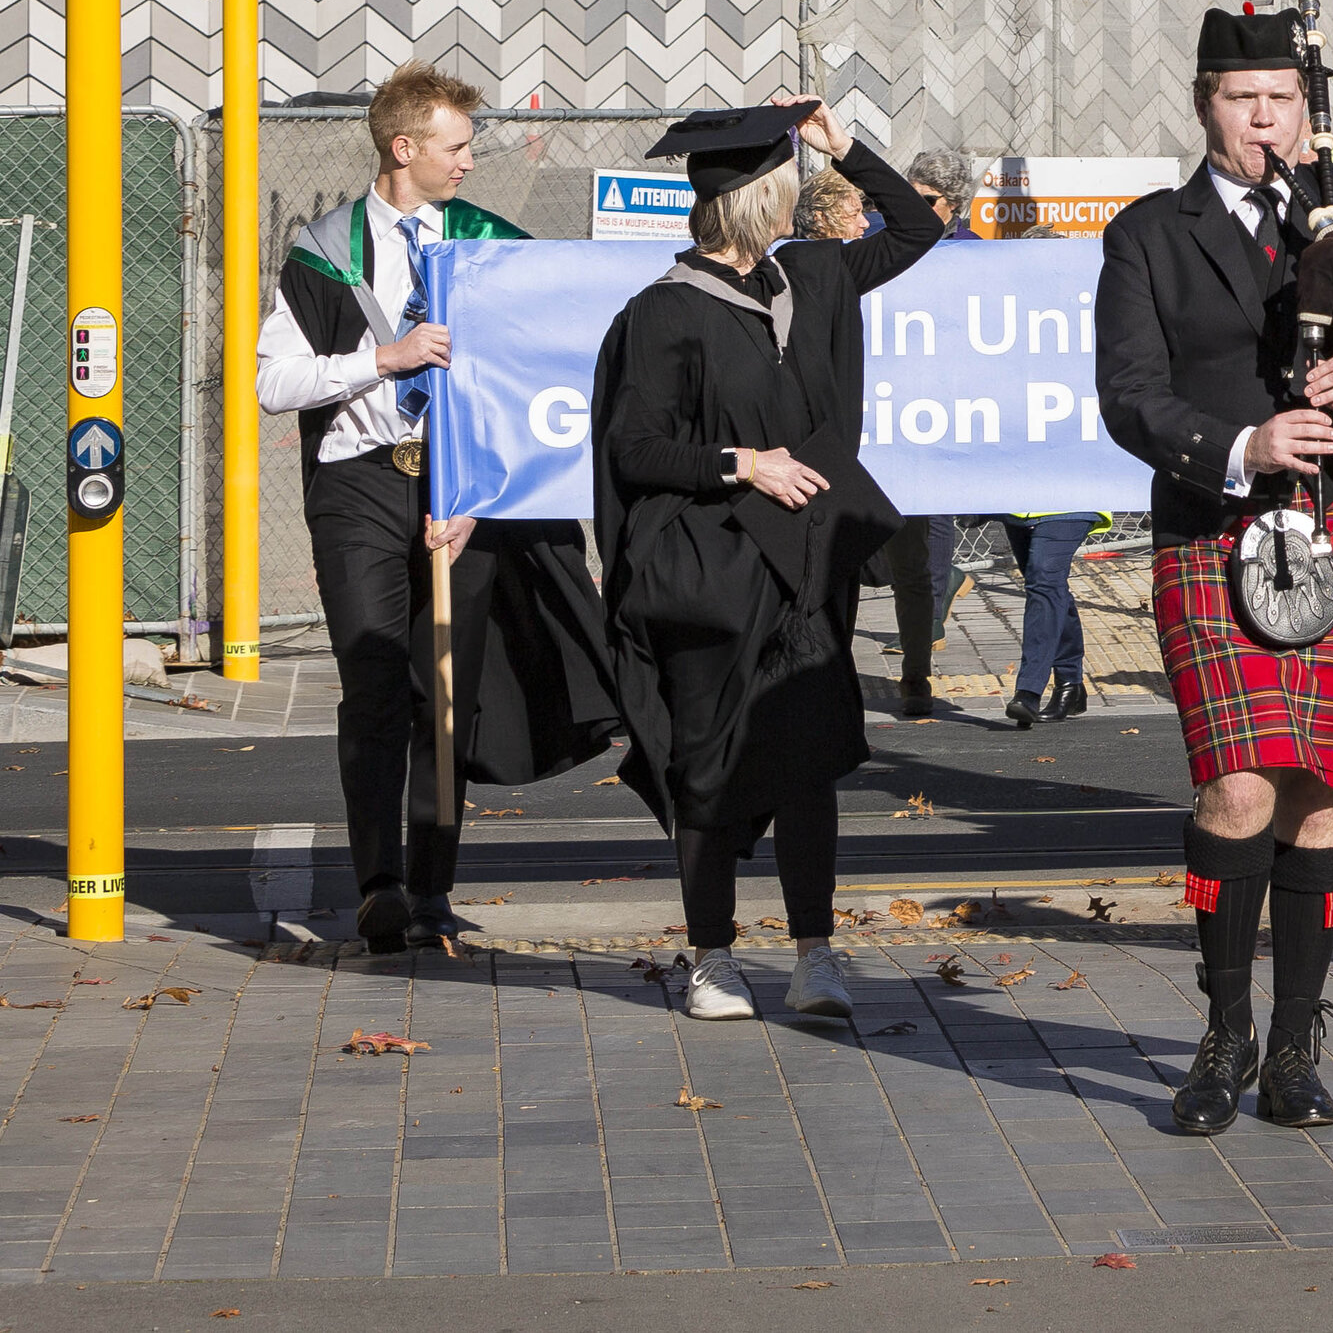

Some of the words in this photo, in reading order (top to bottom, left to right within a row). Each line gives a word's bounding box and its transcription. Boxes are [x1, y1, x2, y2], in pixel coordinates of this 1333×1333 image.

[630, 187, 697, 209] ATTENTION
[596, 217, 610, 226] THIS
[612, 218, 618, 226] IS
[625, 219, 655, 229] MULTIPLE
[656, 220, 683, 230] HAZARD
[226, 644, 246, 654] LIVE
